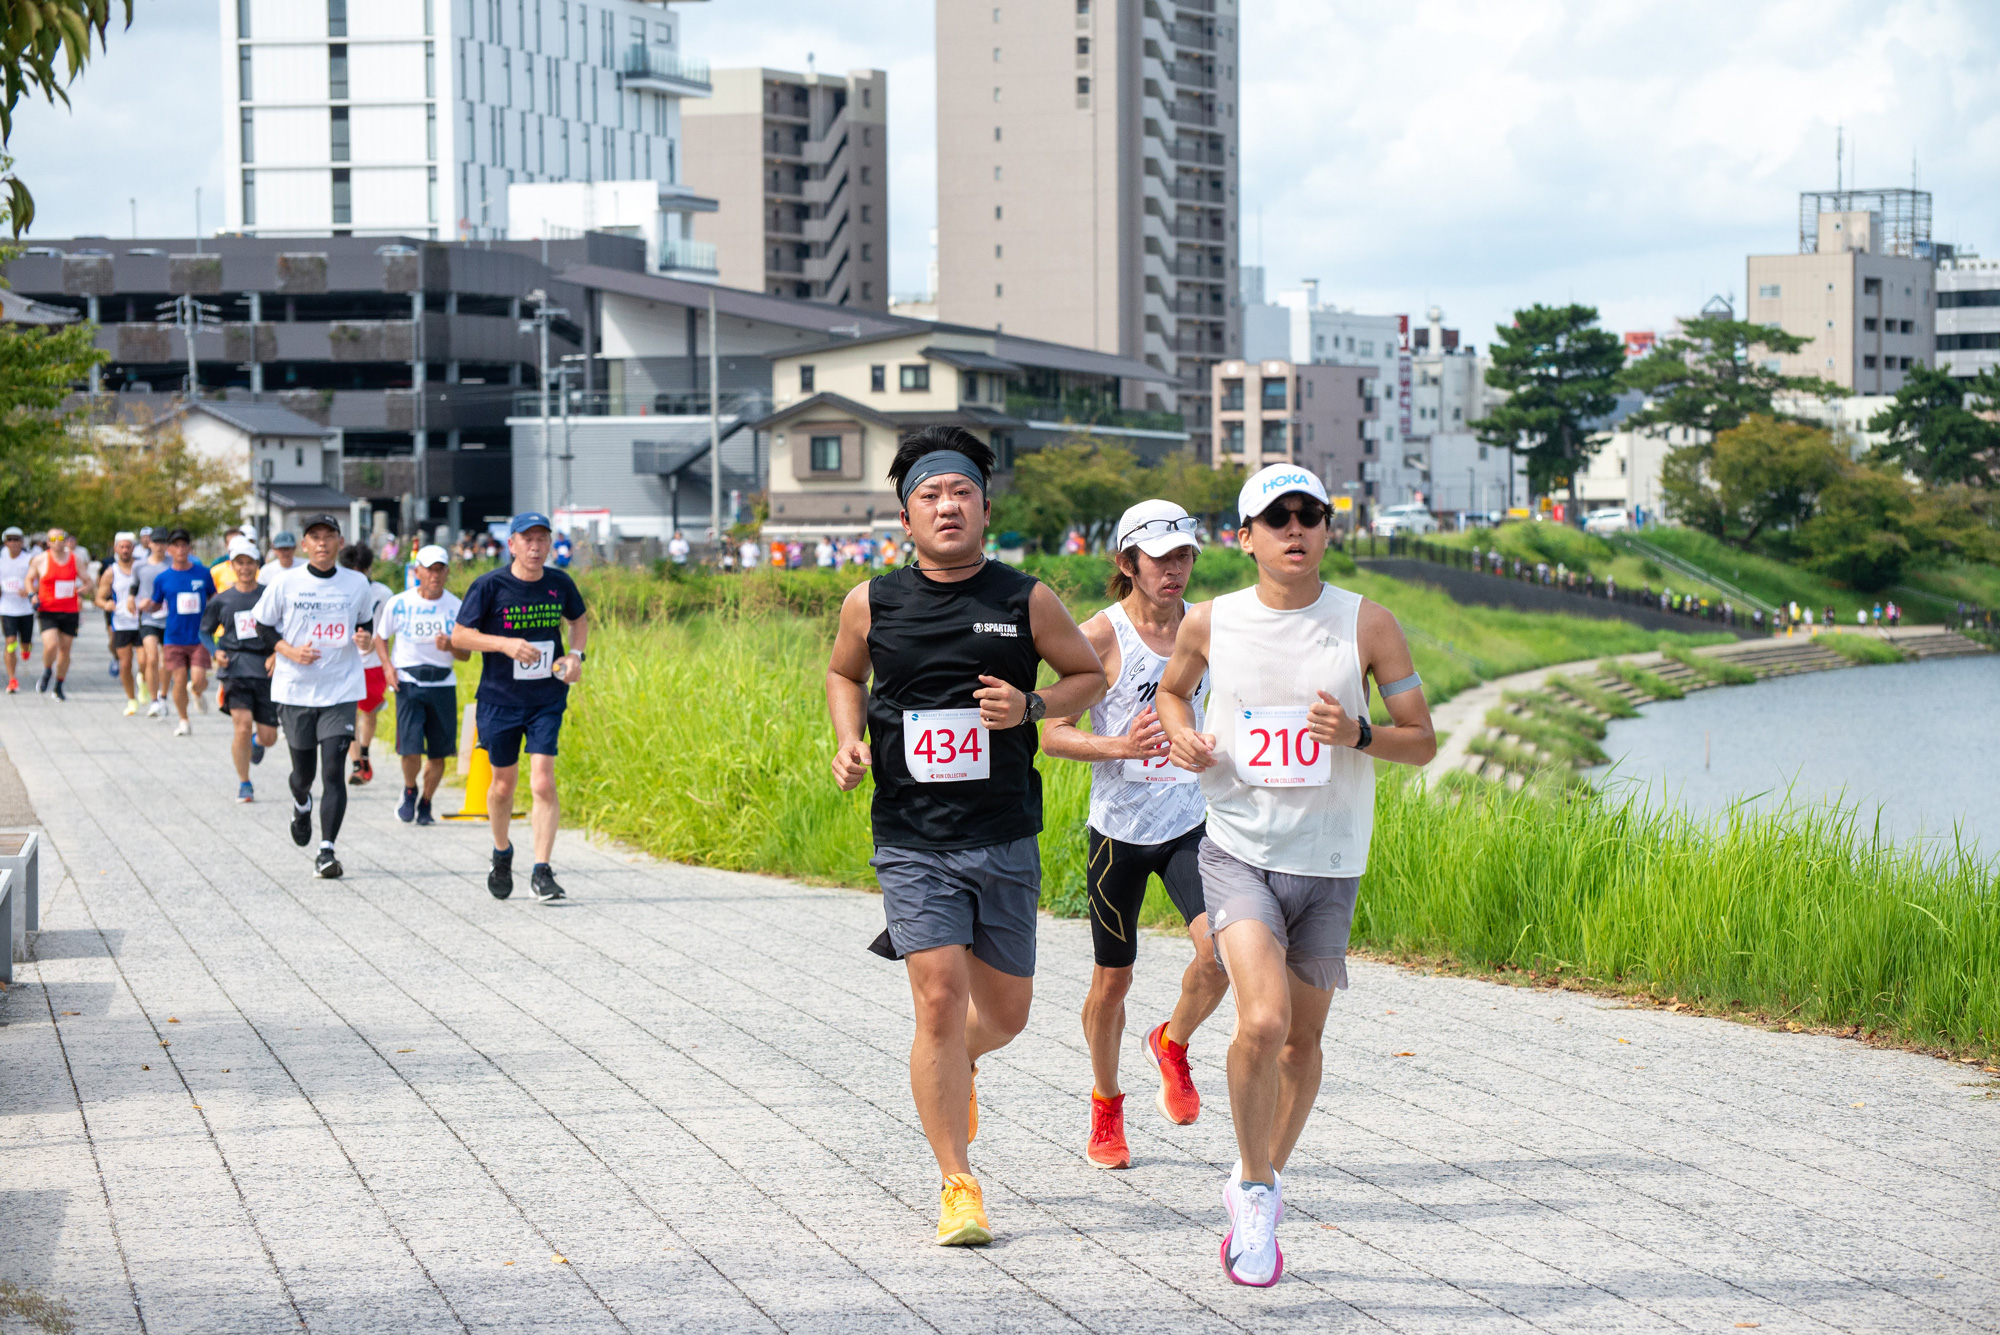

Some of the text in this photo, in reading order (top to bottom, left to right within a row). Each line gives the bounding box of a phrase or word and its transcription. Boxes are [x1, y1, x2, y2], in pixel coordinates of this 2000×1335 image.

[1262, 474, 1309, 494] HOKA
[503, 612, 561, 620] INTERNATIONA
[312, 623, 345, 640] 449
[415, 621, 442, 636] 839
[984, 623, 1017, 633] SPARTAN
[914, 727, 982, 764] 434
[1248, 727, 1320, 767] 210
